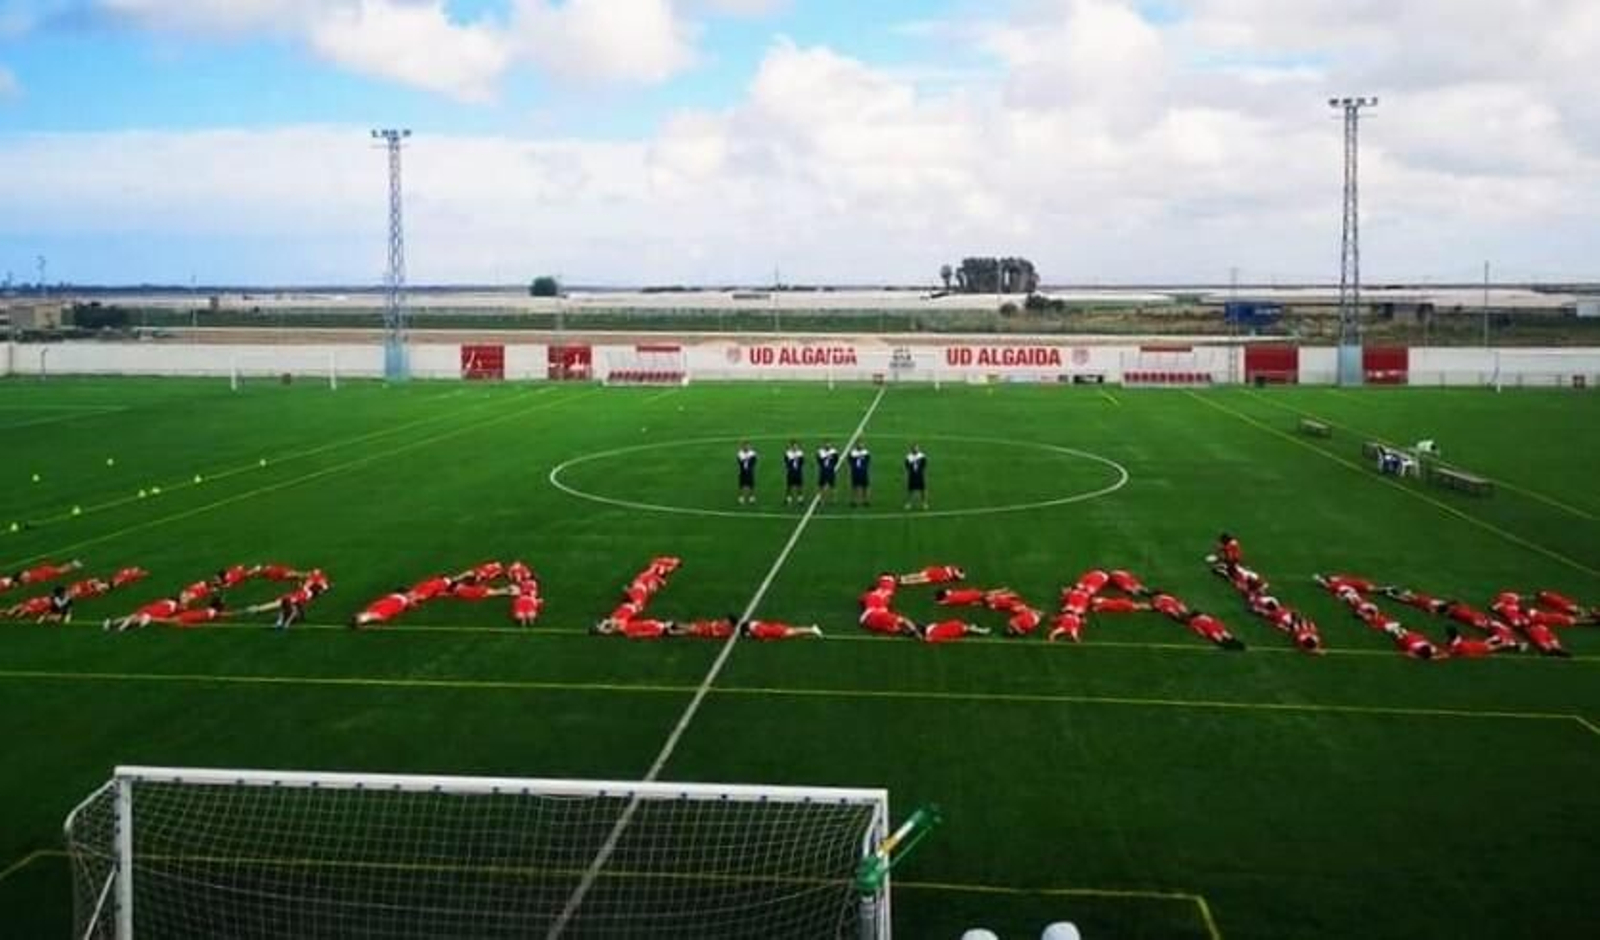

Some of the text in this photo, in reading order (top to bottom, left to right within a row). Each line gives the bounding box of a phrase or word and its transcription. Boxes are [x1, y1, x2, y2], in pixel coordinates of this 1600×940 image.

[750, 347, 857, 365] UD ALGAIDA
[947, 347, 1062, 366] UD ALGAIDA
